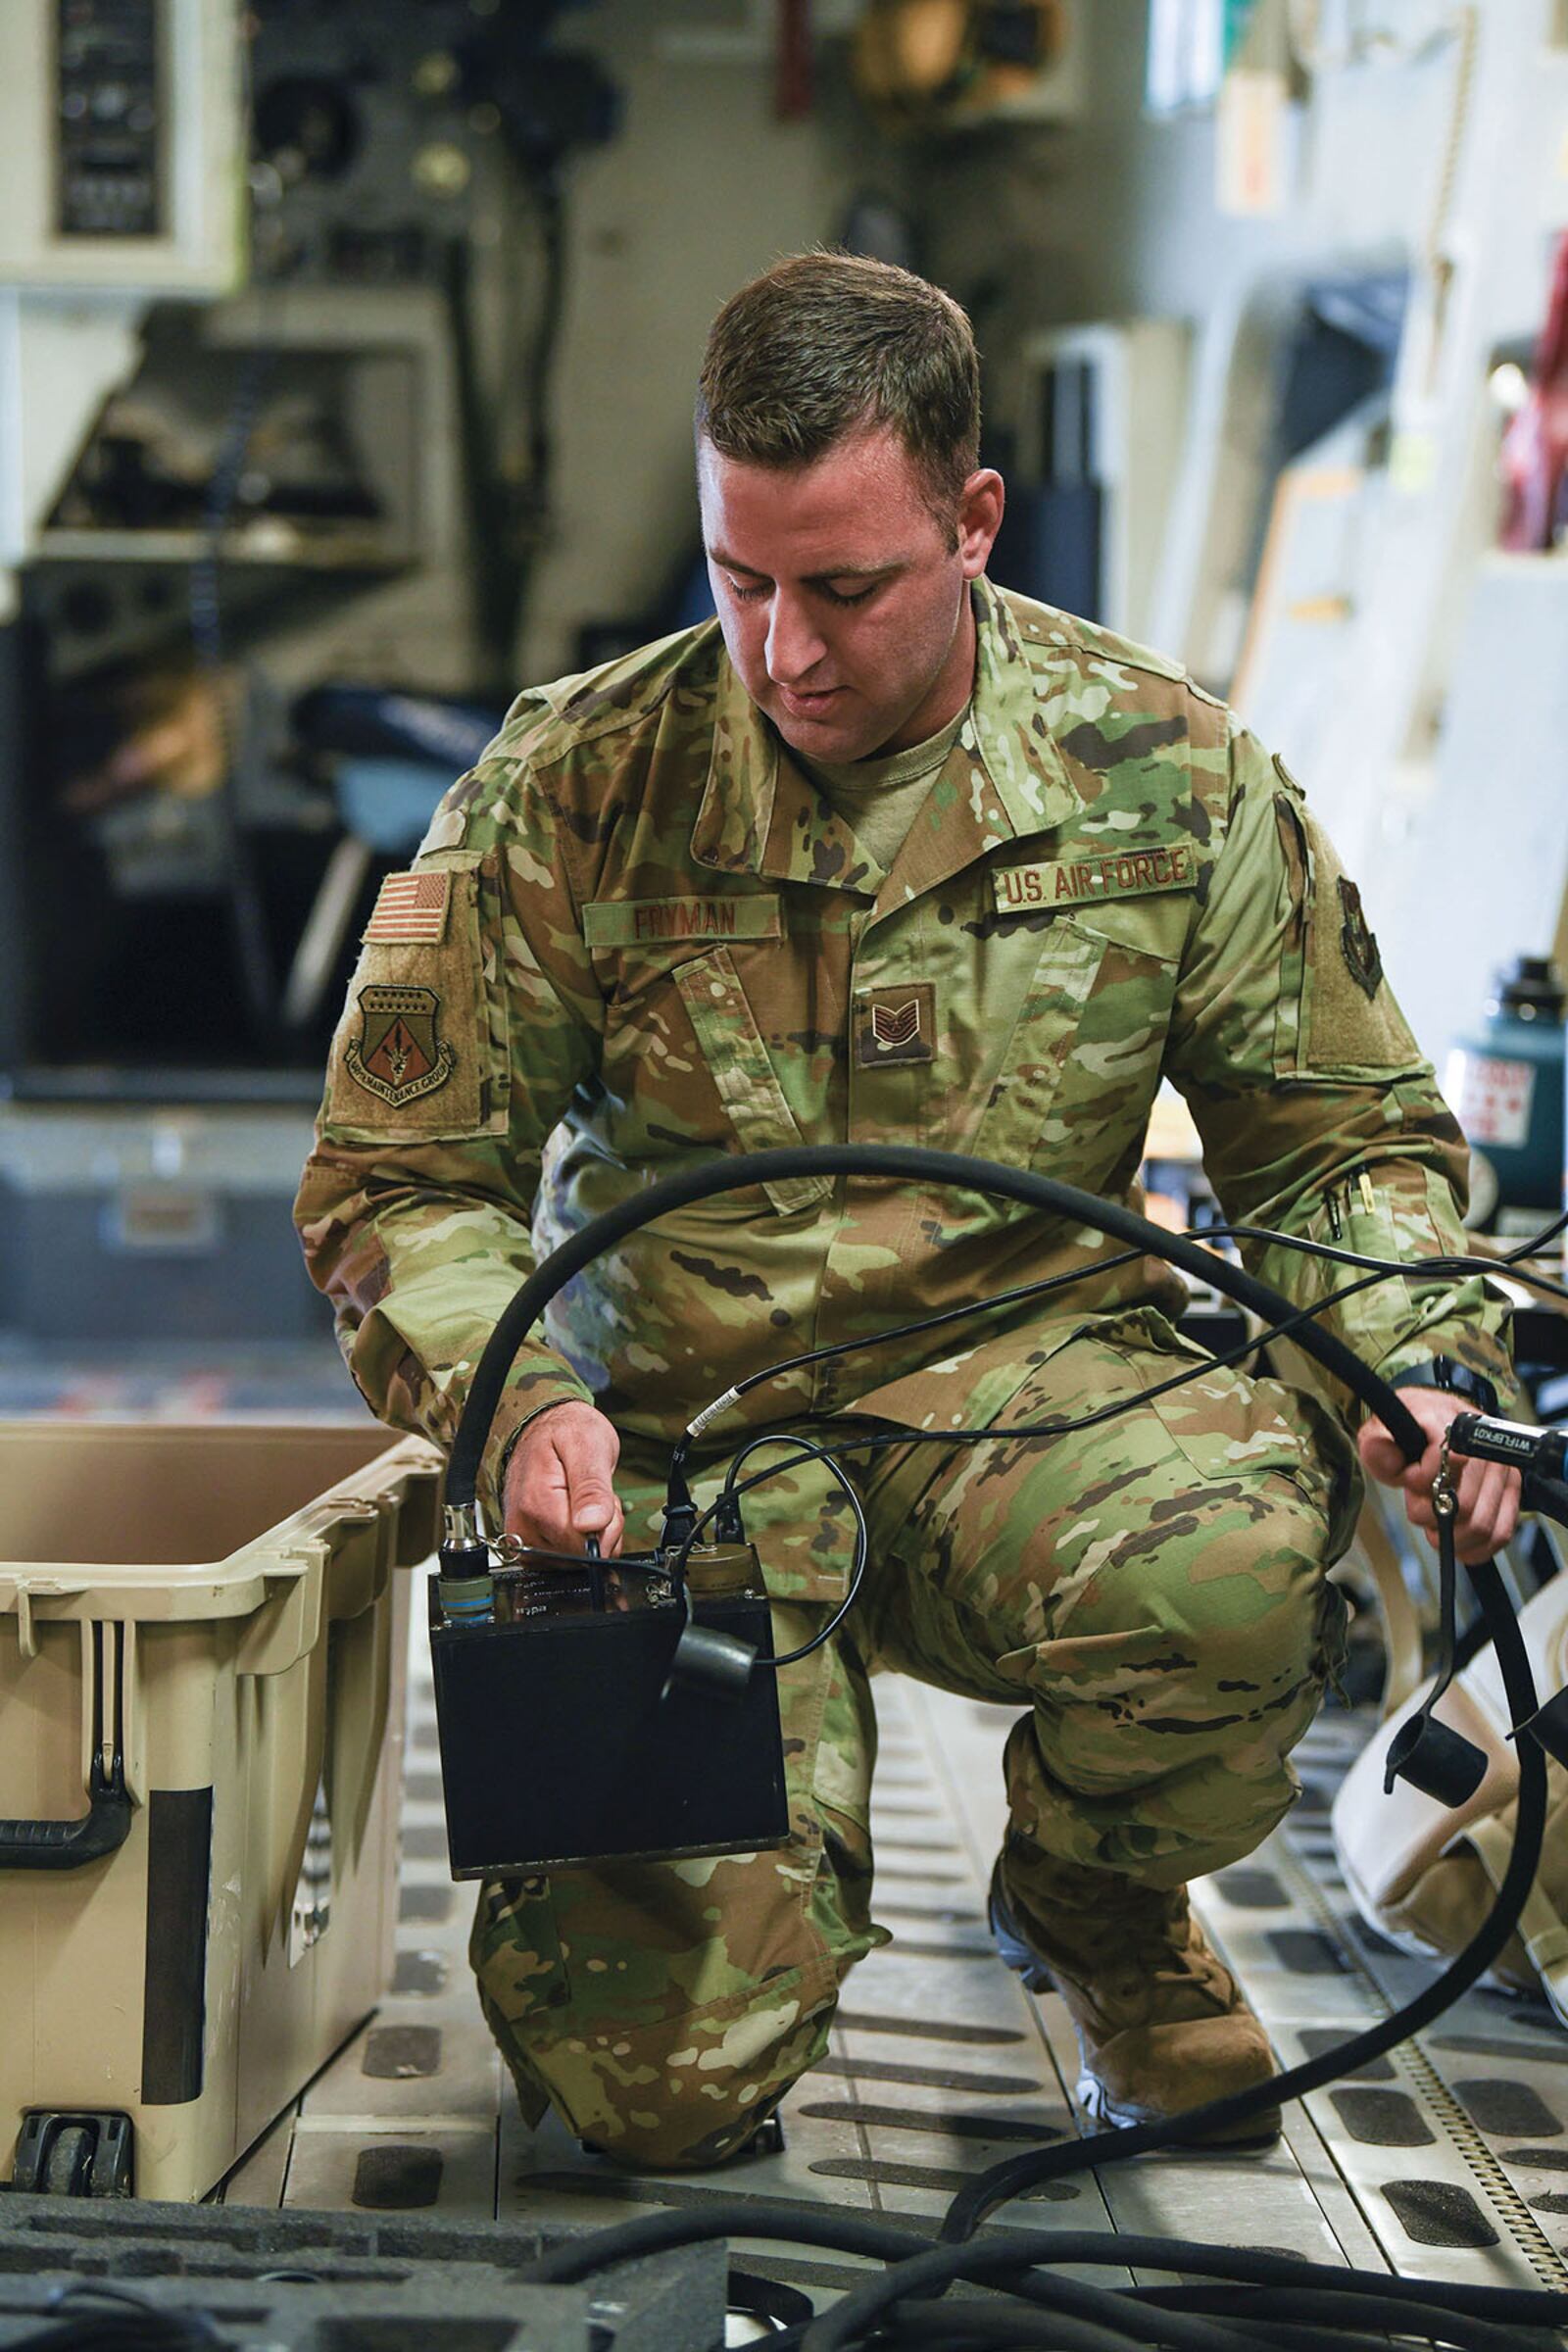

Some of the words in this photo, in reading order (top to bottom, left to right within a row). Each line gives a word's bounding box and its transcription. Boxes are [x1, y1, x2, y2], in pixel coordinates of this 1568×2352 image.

[1004, 870, 1047, 904] U.S.
[1054, 863, 1097, 900] AIR
[1100, 849, 1189, 894] FORCE
[635, 901, 736, 939] FRYMAN
[421, 1062, 448, 1089] GROUP
